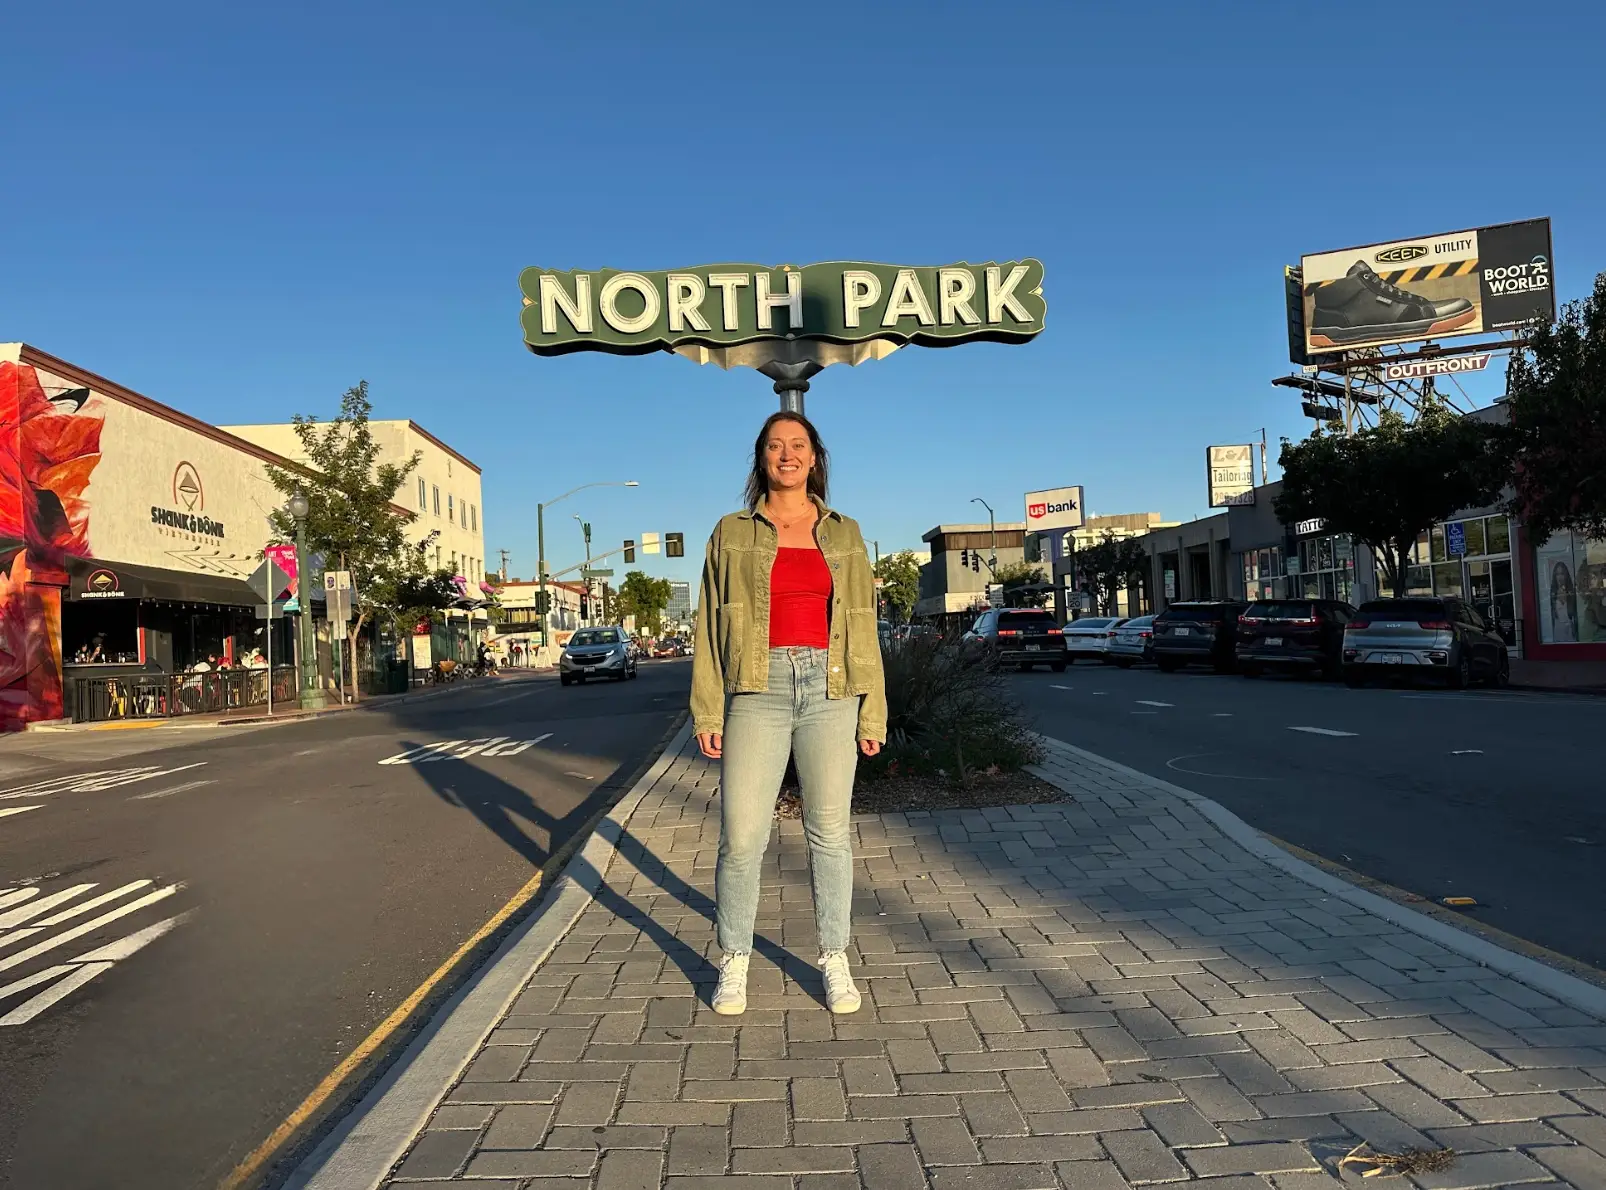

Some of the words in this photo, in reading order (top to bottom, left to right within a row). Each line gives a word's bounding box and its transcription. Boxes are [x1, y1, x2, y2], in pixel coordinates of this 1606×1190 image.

[1376, 247, 1427, 262] KEEN
[1434, 239, 1472, 254] UTILITY
[1484, 264, 1528, 281] BOOT
[538, 270, 804, 334] NORTH
[842, 265, 1035, 329] PARK
[1389, 355, 1486, 378] OUTFRONT
[1047, 499, 1077, 513] bank
[1069, 600, 1081, 608] 20
